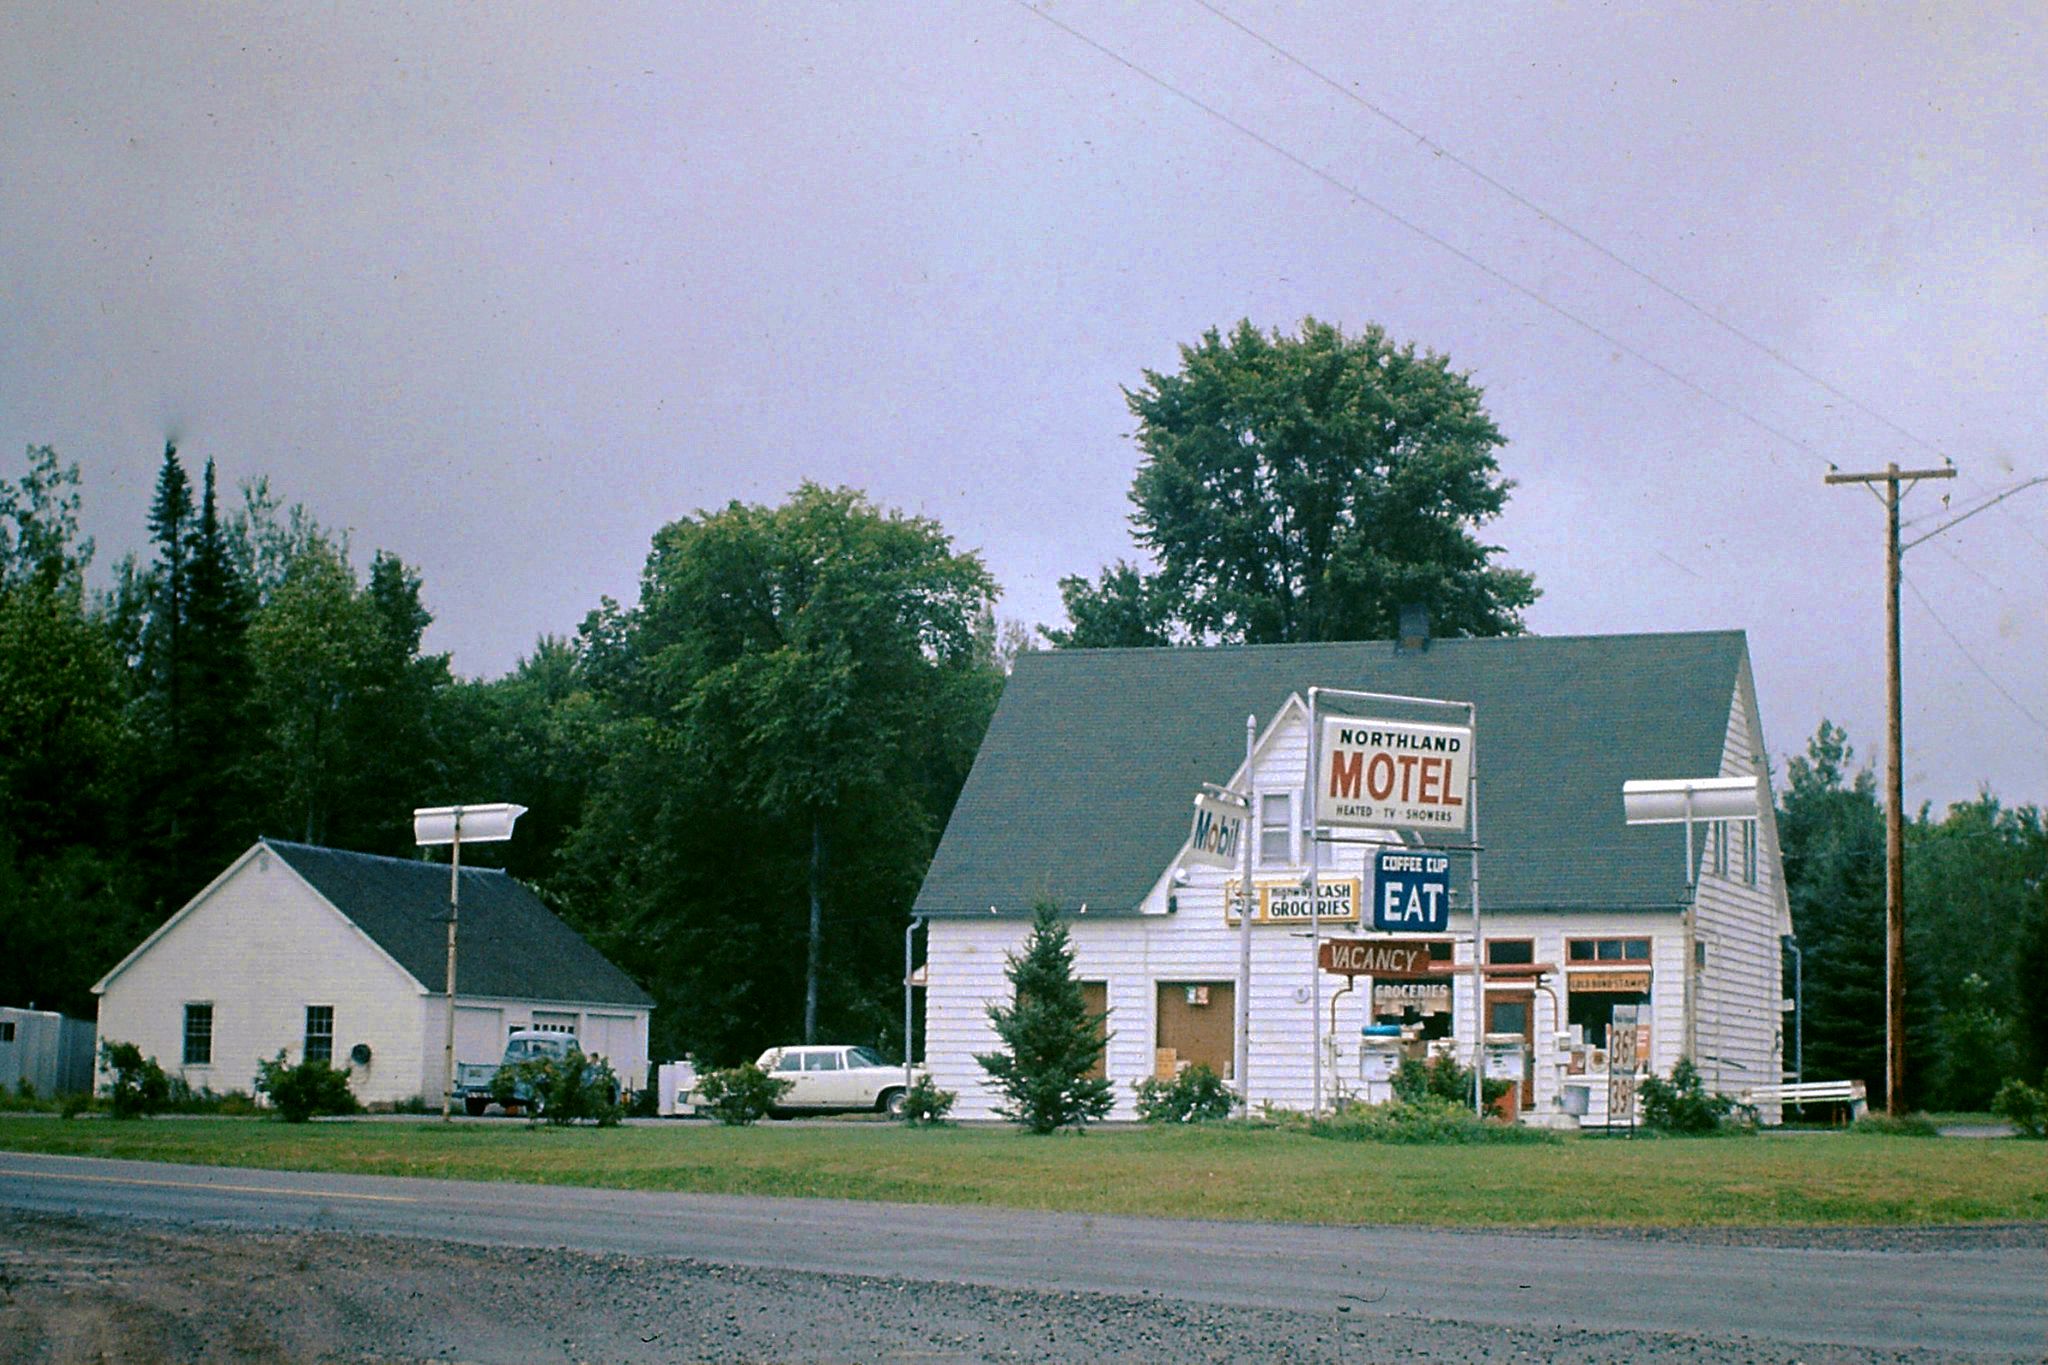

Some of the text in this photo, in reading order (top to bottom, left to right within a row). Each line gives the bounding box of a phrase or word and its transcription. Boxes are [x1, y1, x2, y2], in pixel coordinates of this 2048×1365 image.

[1340, 729, 1460, 752] NORTHLAND
[1329, 750, 1462, 806] MOTEL
[1336, 805, 1452, 822] HEATED TV SHOWERS
[1193, 809, 1240, 857] Mobil
[1382, 855, 1448, 873] COFFEE CUP
[1317, 884, 1350, 898] CASH
[1384, 882, 1444, 922] EAT
[1331, 945, 1418, 972] VACANCY
[1375, 985, 1448, 999] GROCERIES
